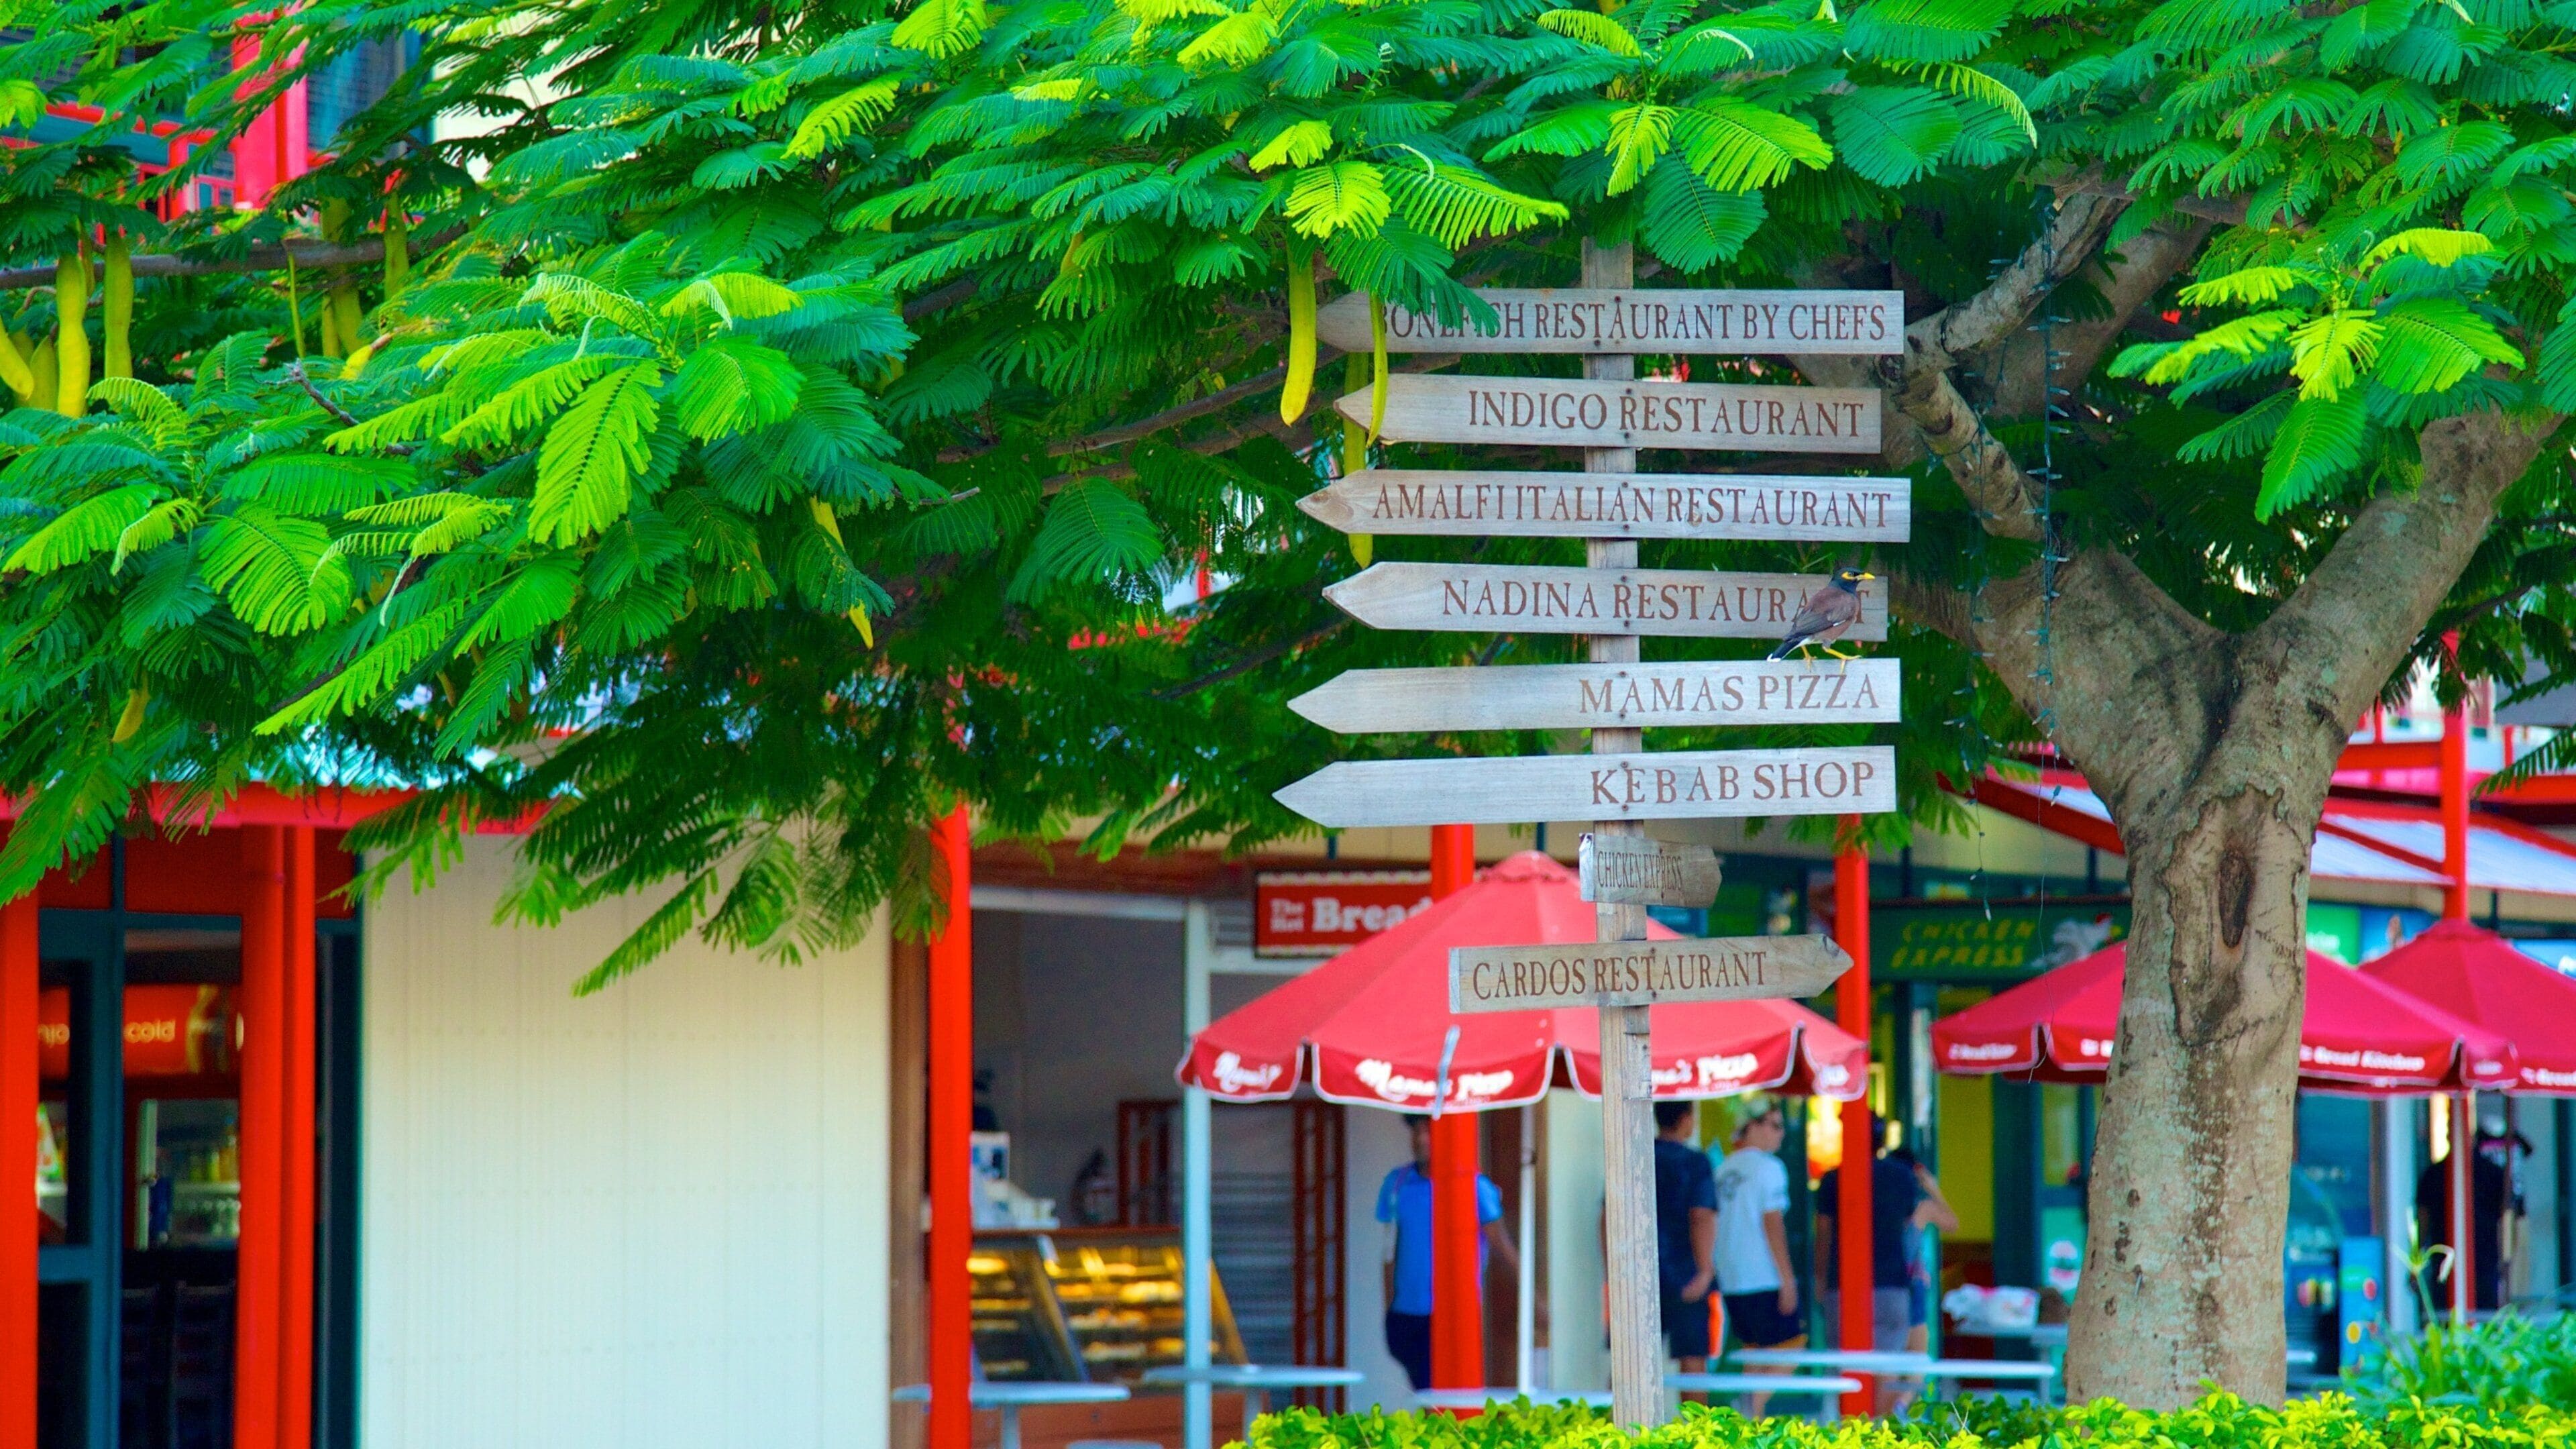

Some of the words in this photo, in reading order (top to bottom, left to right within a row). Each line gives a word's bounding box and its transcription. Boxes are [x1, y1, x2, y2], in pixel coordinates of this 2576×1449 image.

[1535, 302, 1733, 339] RESTAURANT
[1743, 304, 1780, 339] BY
[1788, 304, 1885, 340] CHEFS
[1468, 390, 1607, 430] INDIGO
[1619, 395, 1864, 437] RESTAURANT
[1373, 483, 1505, 519] AMALFI
[1515, 485, 1655, 523] ITALIAN
[1666, 488, 1891, 527] RESTAURANT
[1442, 580, 1600, 619] NADINA
[1613, 584, 1870, 625] RESTAURAT
[1579, 676, 1744, 713] MAMAS
[1758, 674, 1879, 710] PIZZA
[1591, 765, 1739, 804] KEBAB
[1753, 761, 1874, 800] SHOP
[1597, 851, 1642, 888] CHICKEN
[1644, 853, 1682, 890] EXPRESS
[1901, 918, 2036, 943] CHICKEN
[1473, 957, 1587, 1000] CARDOS
[1593, 951, 1767, 996] RESTAURANT
[1890, 943, 2025, 969] EXPRESS
[123, 1019, 176, 1044] cold
